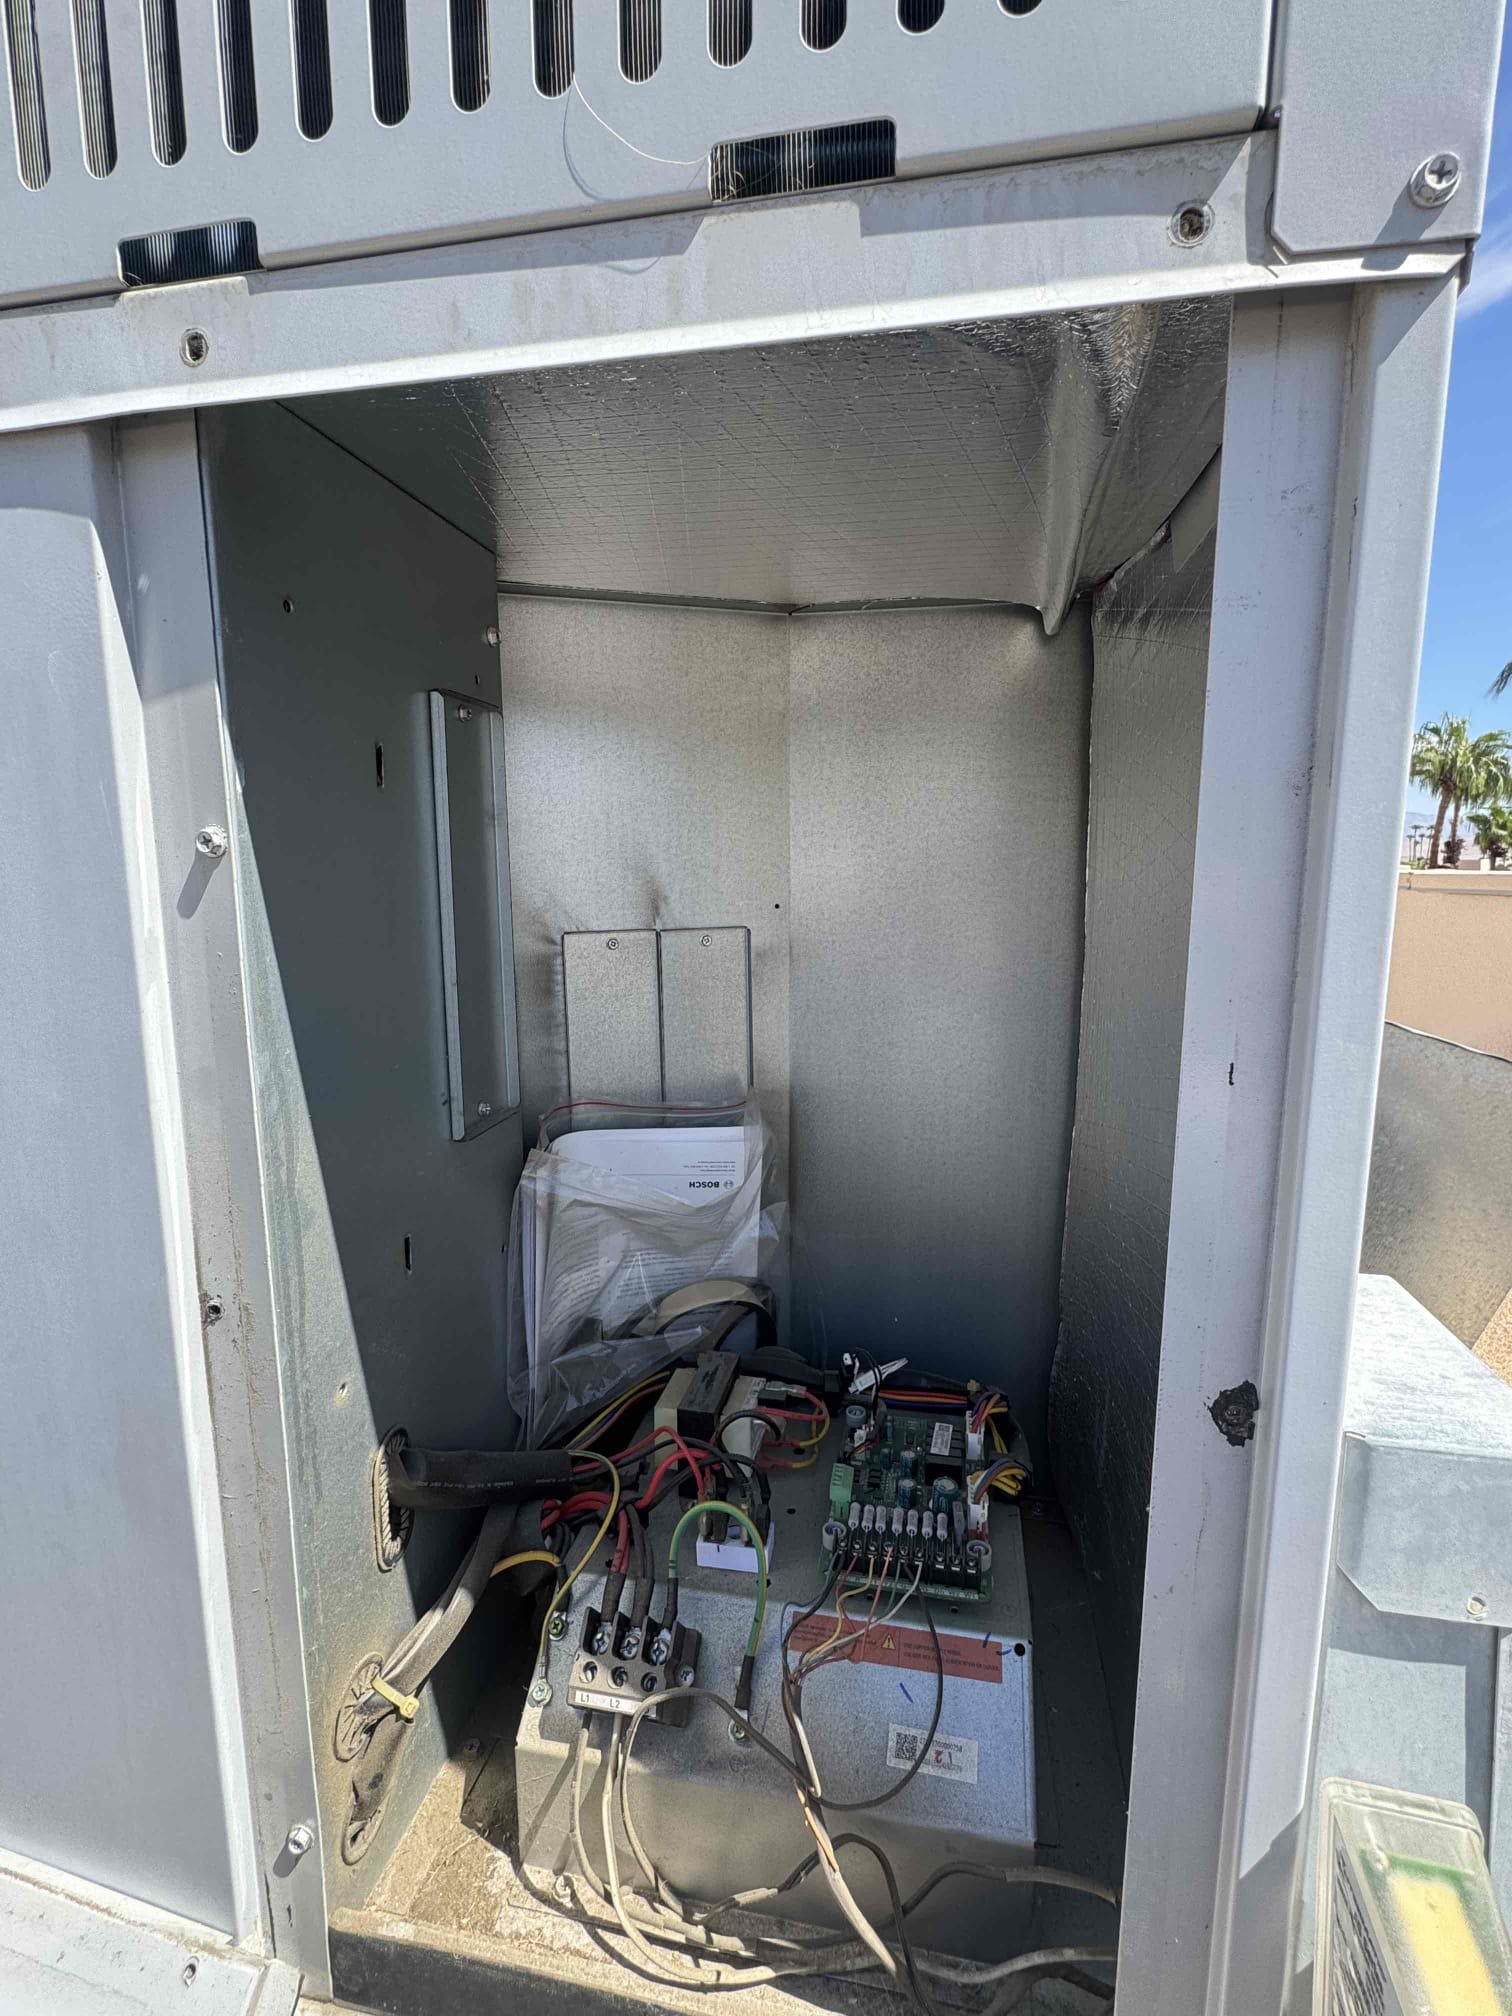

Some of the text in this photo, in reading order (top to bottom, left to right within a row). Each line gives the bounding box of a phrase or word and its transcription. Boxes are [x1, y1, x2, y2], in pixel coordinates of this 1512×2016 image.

[688, 1181, 720, 1189] BOSCH
[580, 1693, 621, 1709] L1 L2
